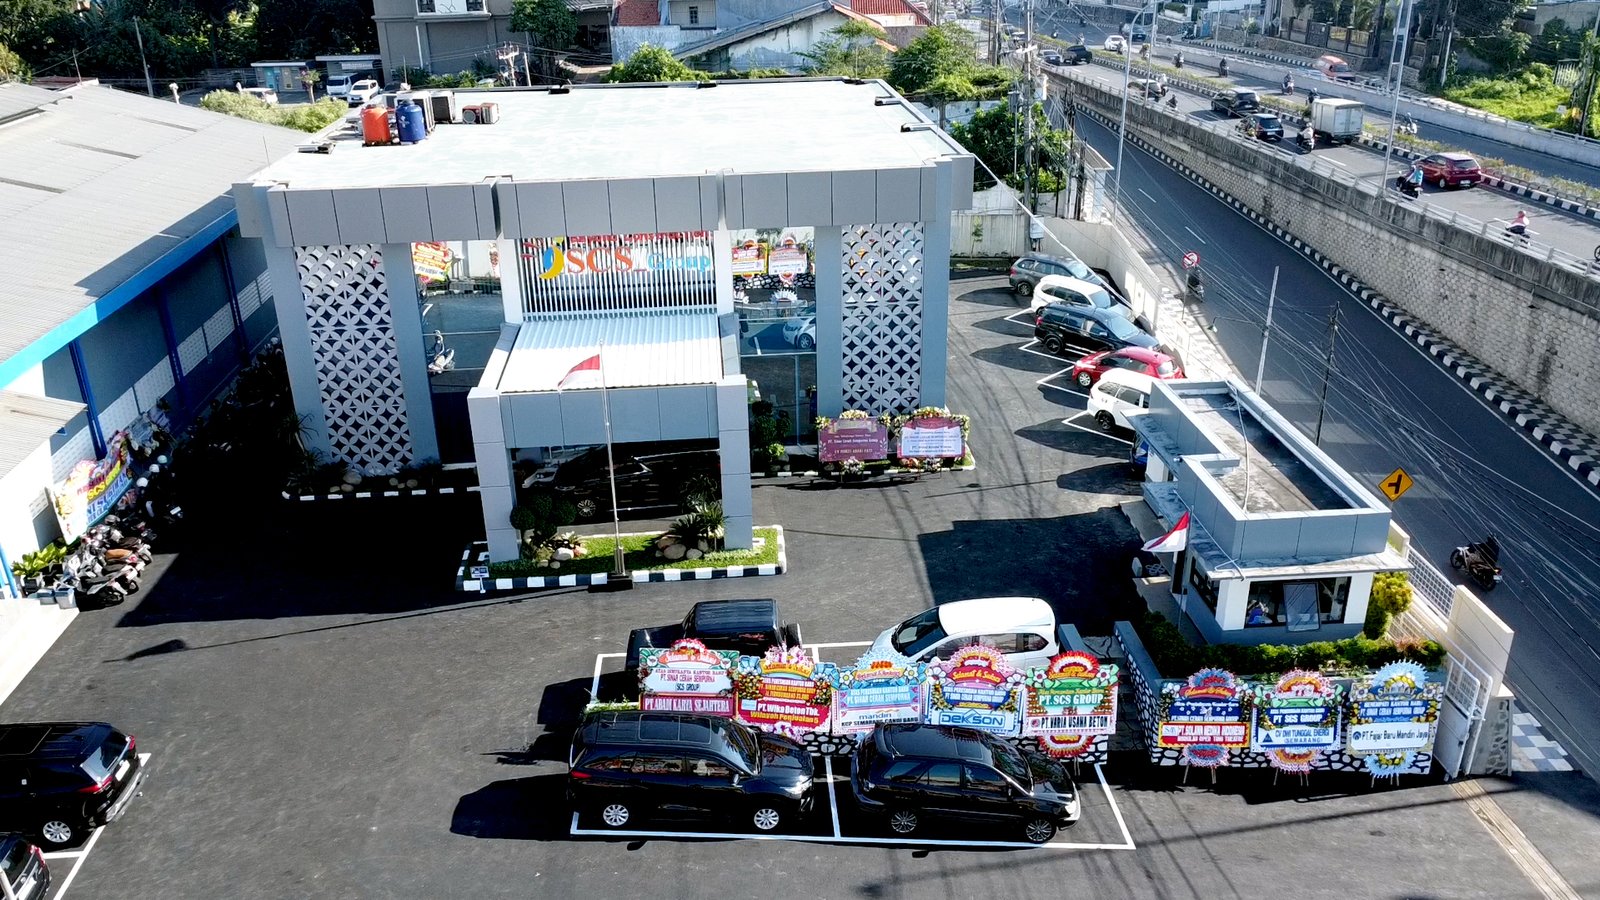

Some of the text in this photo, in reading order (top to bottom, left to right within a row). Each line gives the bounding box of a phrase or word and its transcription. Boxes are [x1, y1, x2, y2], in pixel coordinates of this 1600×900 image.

[567, 247, 632, 273] SCS
[648, 253, 711, 272] Group
[952, 670, 977, 680] Selamat
[982, 670, 1001, 682] Sukses
[1073, 694, 1104, 705] GROUP
[750, 711, 779, 720] Wilayah
[779, 713, 813, 723] Penjualan
[1068, 716, 1087, 728] USAHA
[1088, 716, 1108, 728] BETON
[1272, 714, 1323, 724] PT SCS GROUP
[1292, 729, 1312, 737] TUNGGAL
[1314, 728, 1330, 736] ENERGI
[1384, 730, 1396, 740] Baru
[1397, 729, 1416, 740] Mandiri
